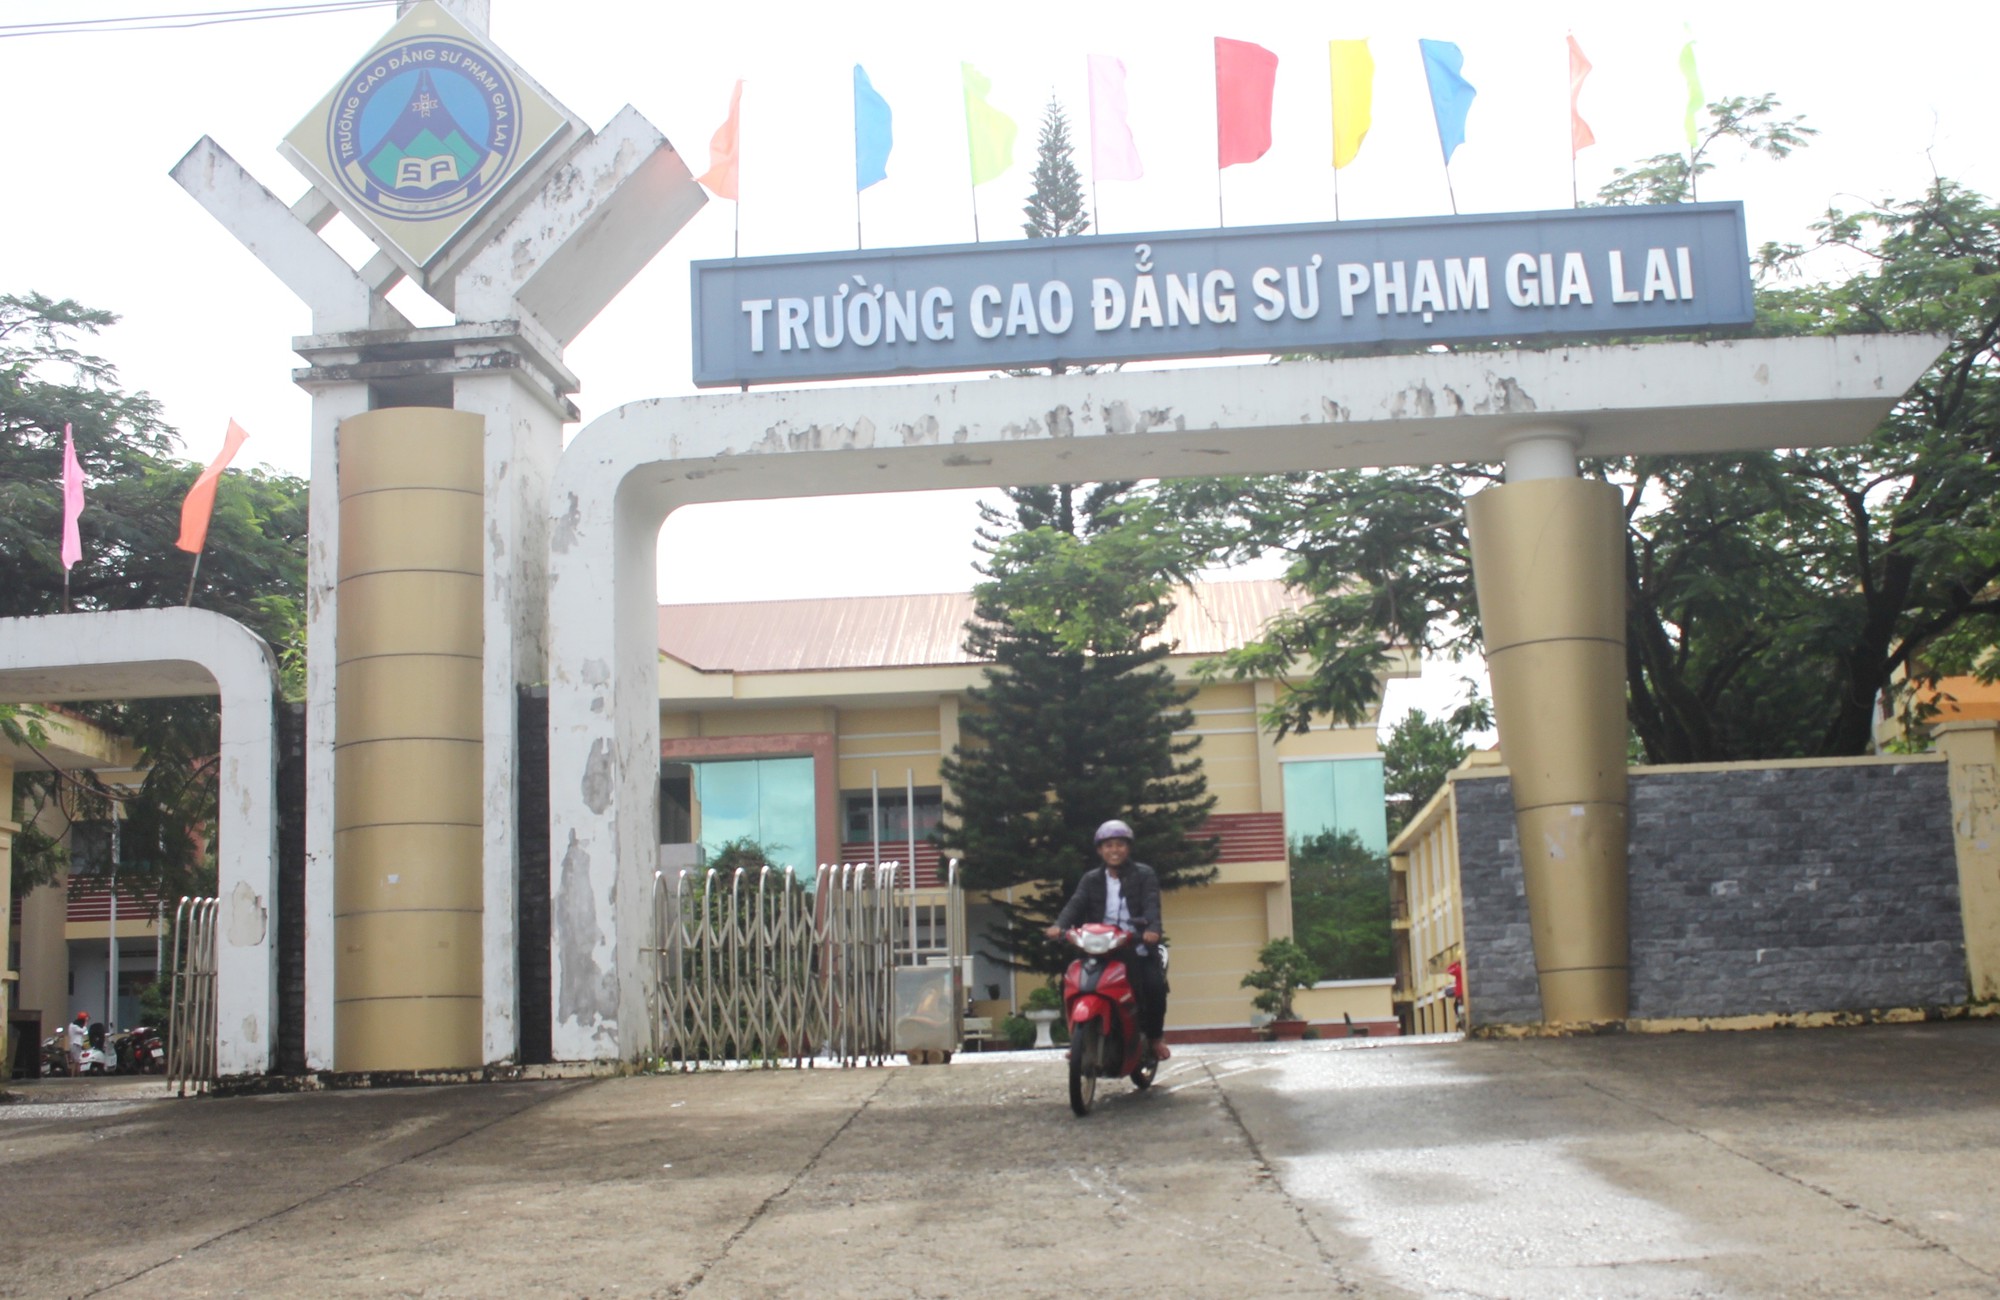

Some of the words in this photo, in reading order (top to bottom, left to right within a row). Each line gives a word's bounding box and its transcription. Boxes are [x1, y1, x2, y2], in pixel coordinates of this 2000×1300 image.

[440, 50, 463, 64] SƯ
[356, 66, 387, 93] CAO
[461, 58, 498, 91] PHẠM
[492, 93, 508, 120] GIA
[493, 124, 508, 147] LAI
[741, 274, 955, 352] TRƯỜNG
[969, 280, 1074, 339] CAO
[1091, 243, 1237, 331] ĐẲNG
[1251, 253, 1323, 322] SƯ
[1337, 256, 1490, 324] PHẠM
[1505, 251, 1594, 307] GIA
[1608, 246, 1694, 304] LAI
